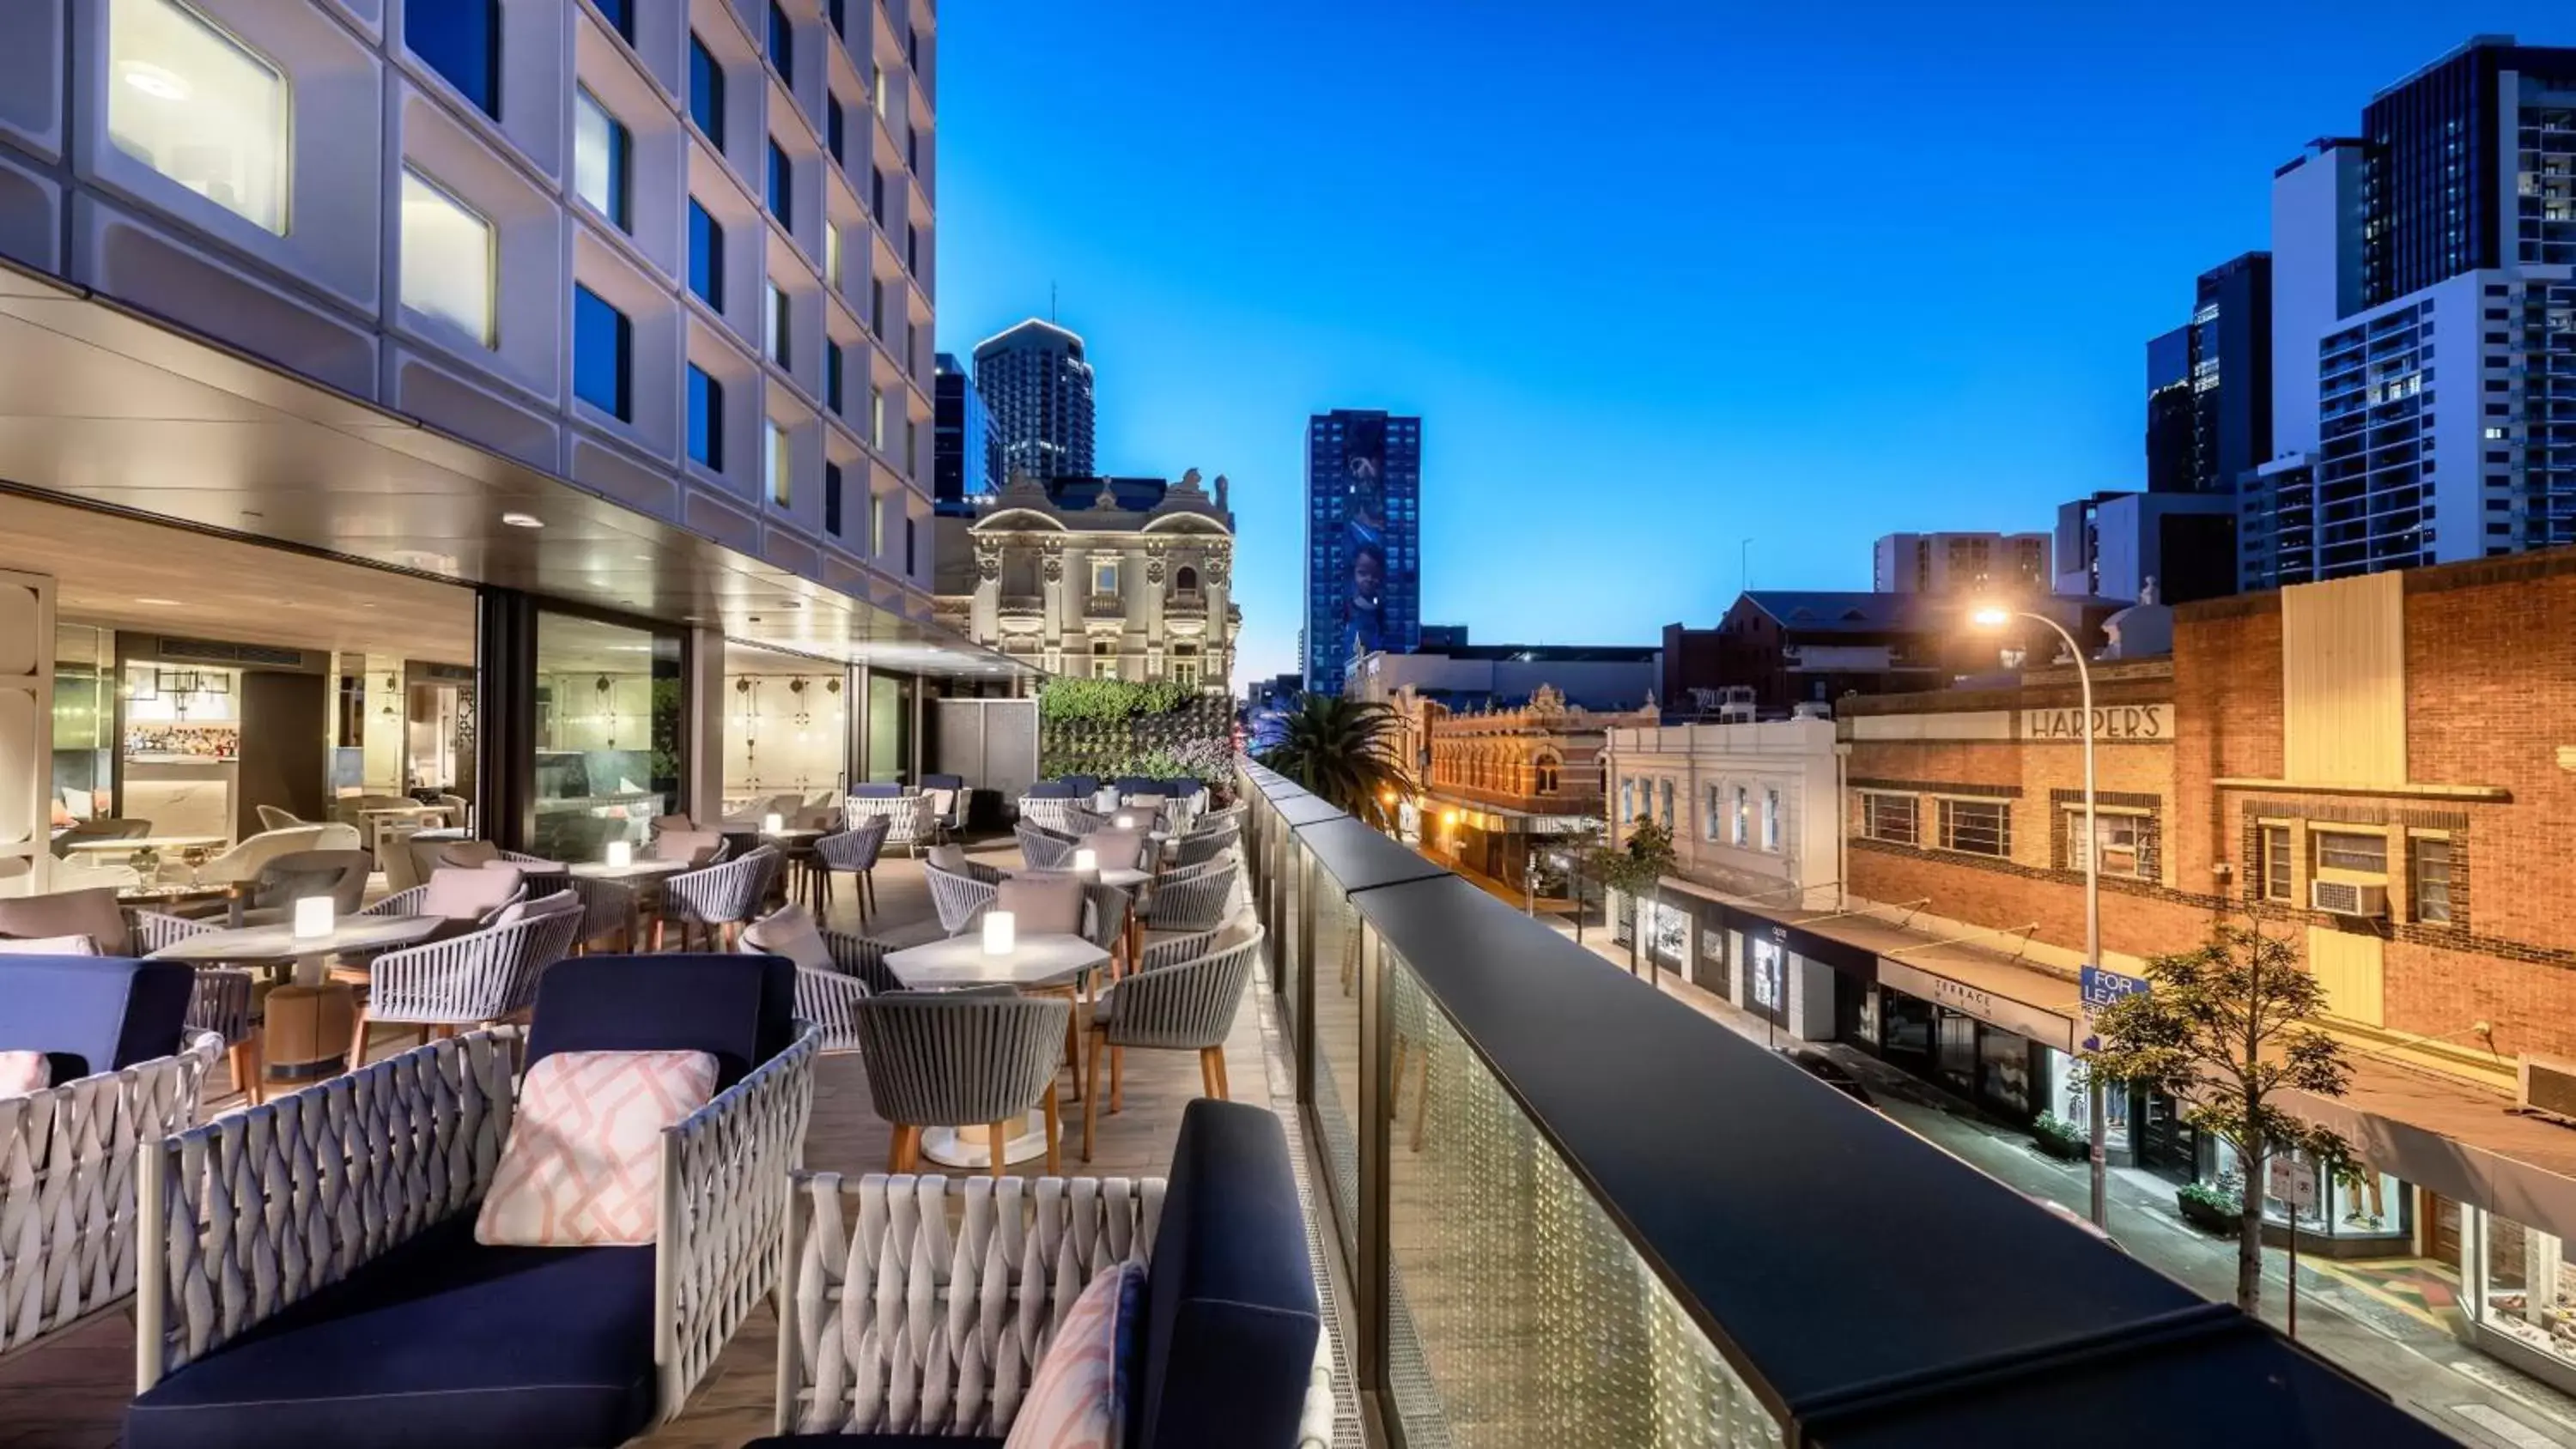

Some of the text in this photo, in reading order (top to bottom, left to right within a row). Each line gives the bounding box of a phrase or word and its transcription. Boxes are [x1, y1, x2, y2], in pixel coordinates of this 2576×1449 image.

[2032, 706, 2160, 737] HARPER'S
[2094, 971, 2132, 994] FOR
[2084, 985, 2117, 1005] LEA
